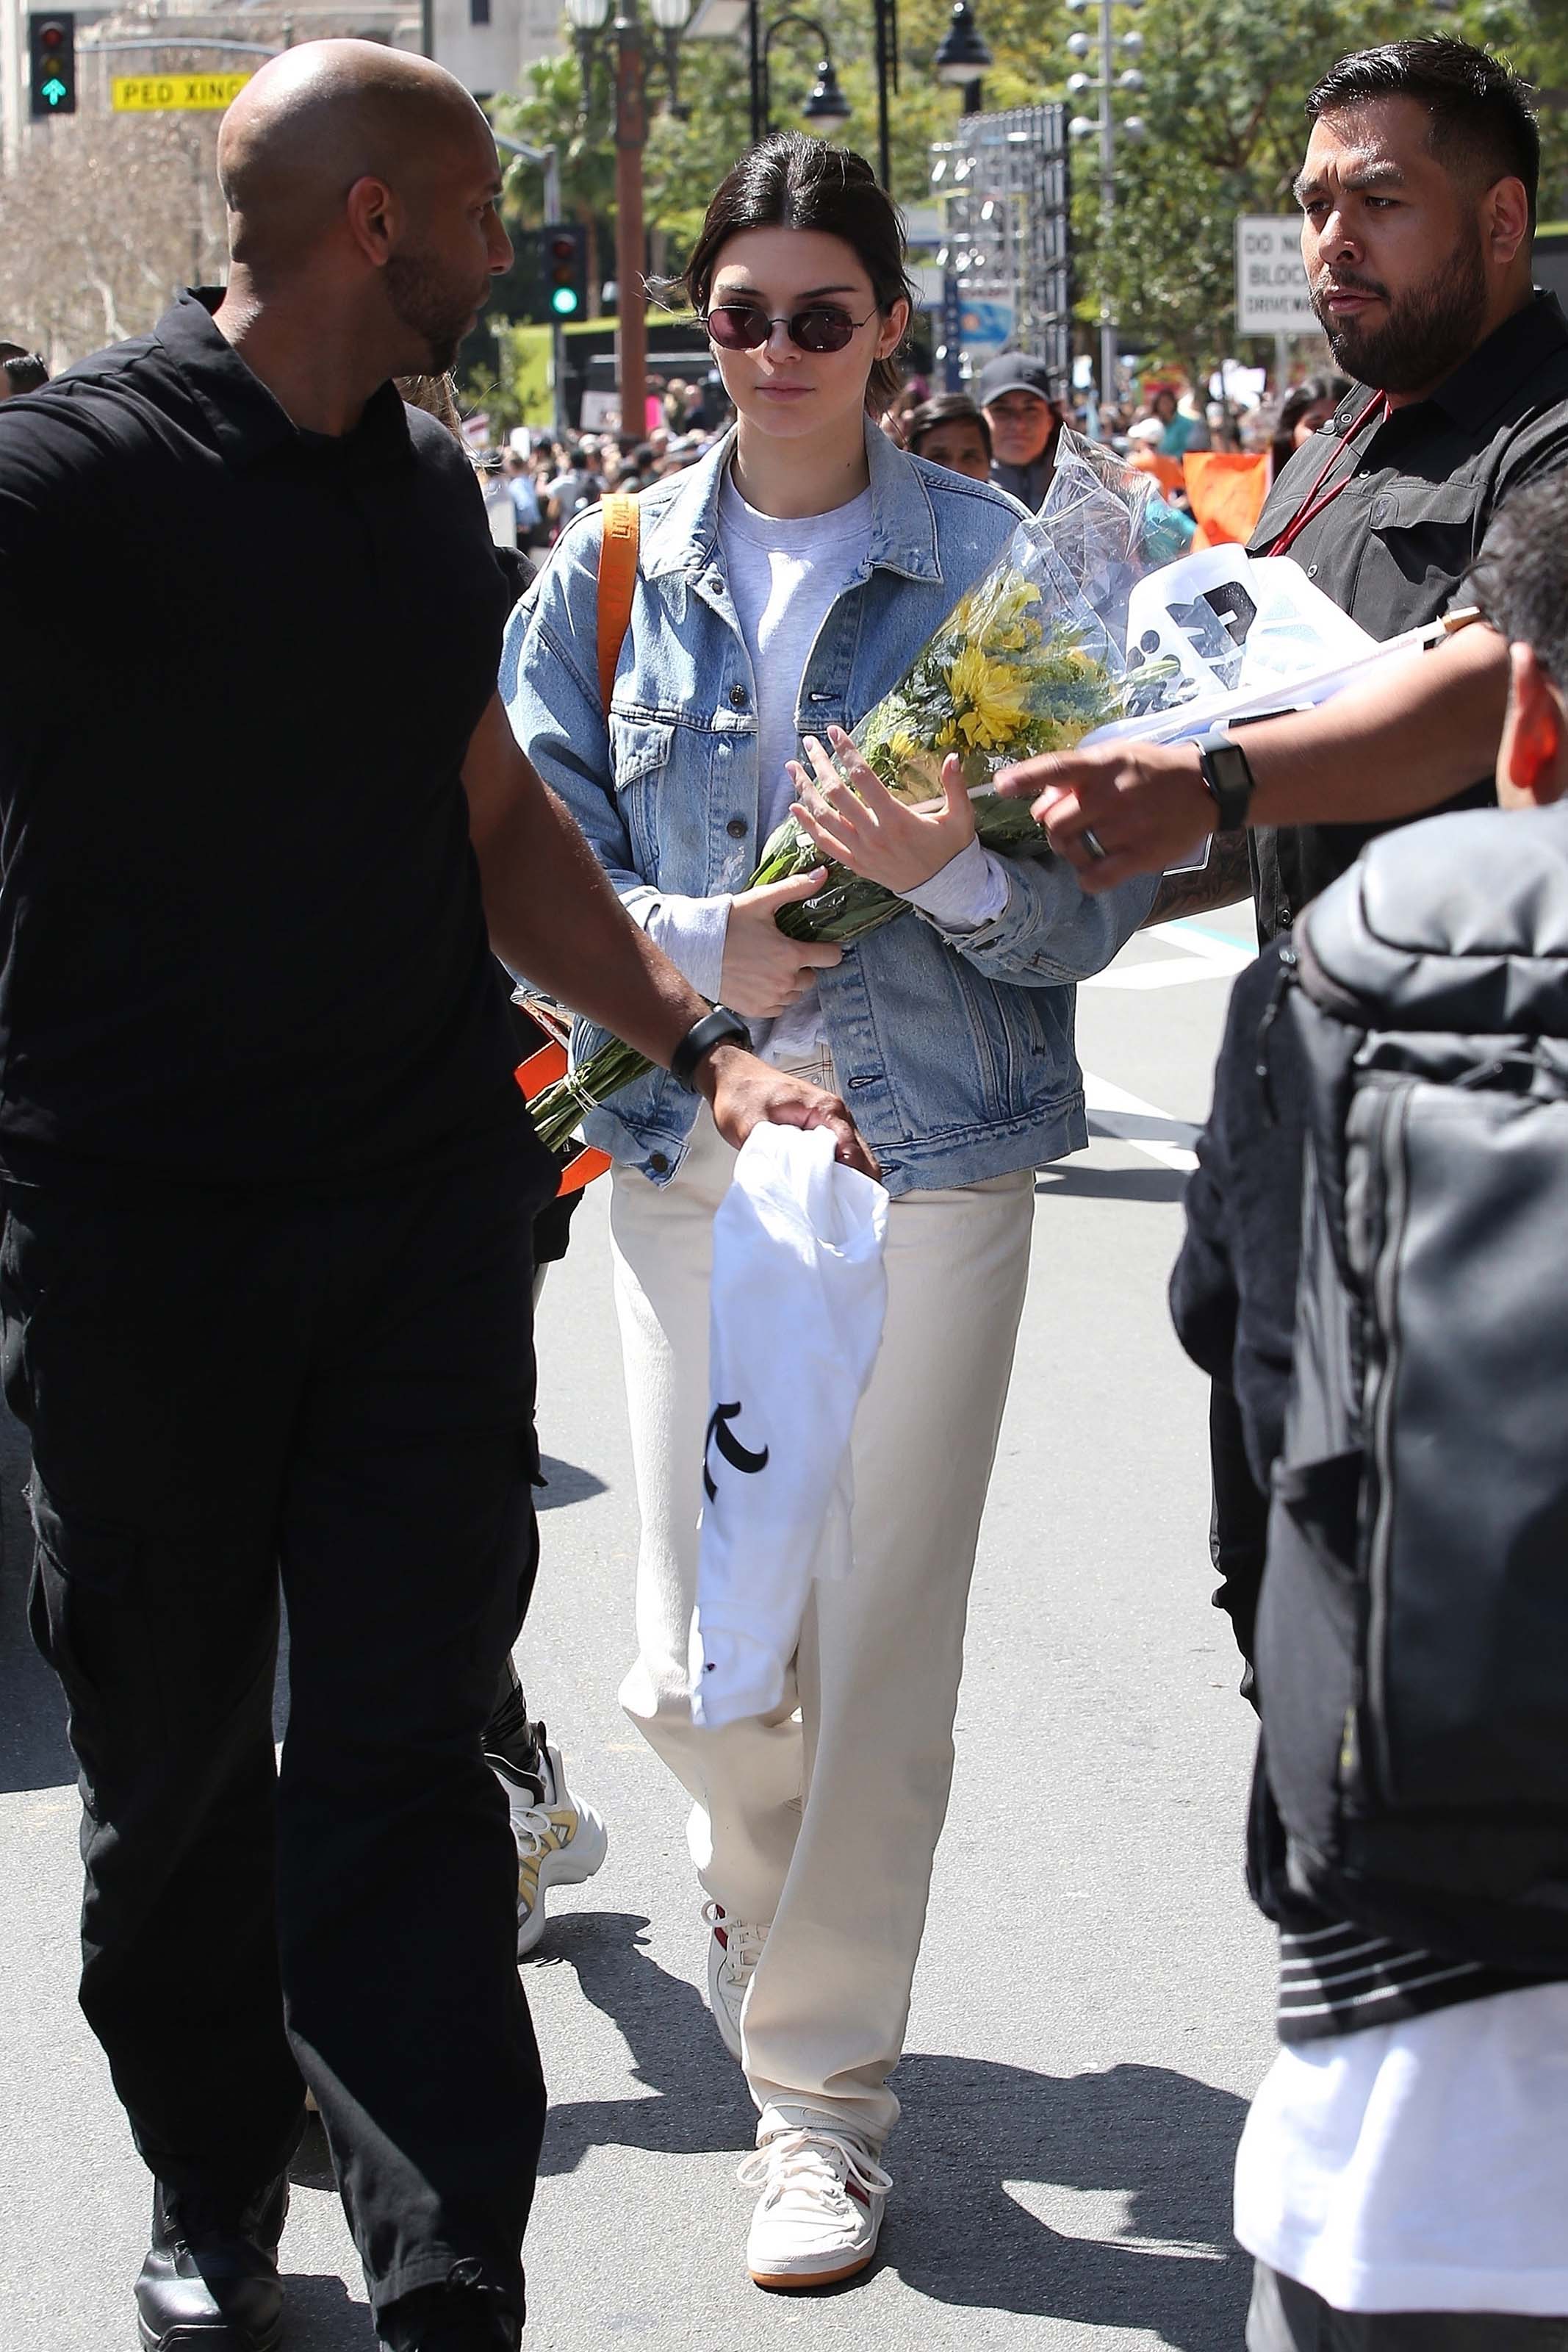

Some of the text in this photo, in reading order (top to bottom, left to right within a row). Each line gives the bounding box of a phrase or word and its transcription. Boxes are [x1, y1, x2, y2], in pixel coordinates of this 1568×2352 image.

[123, 82, 173, 104] PED
[1245, 233, 1272, 255] DO
[1251, 265, 1306, 287] BLOC
